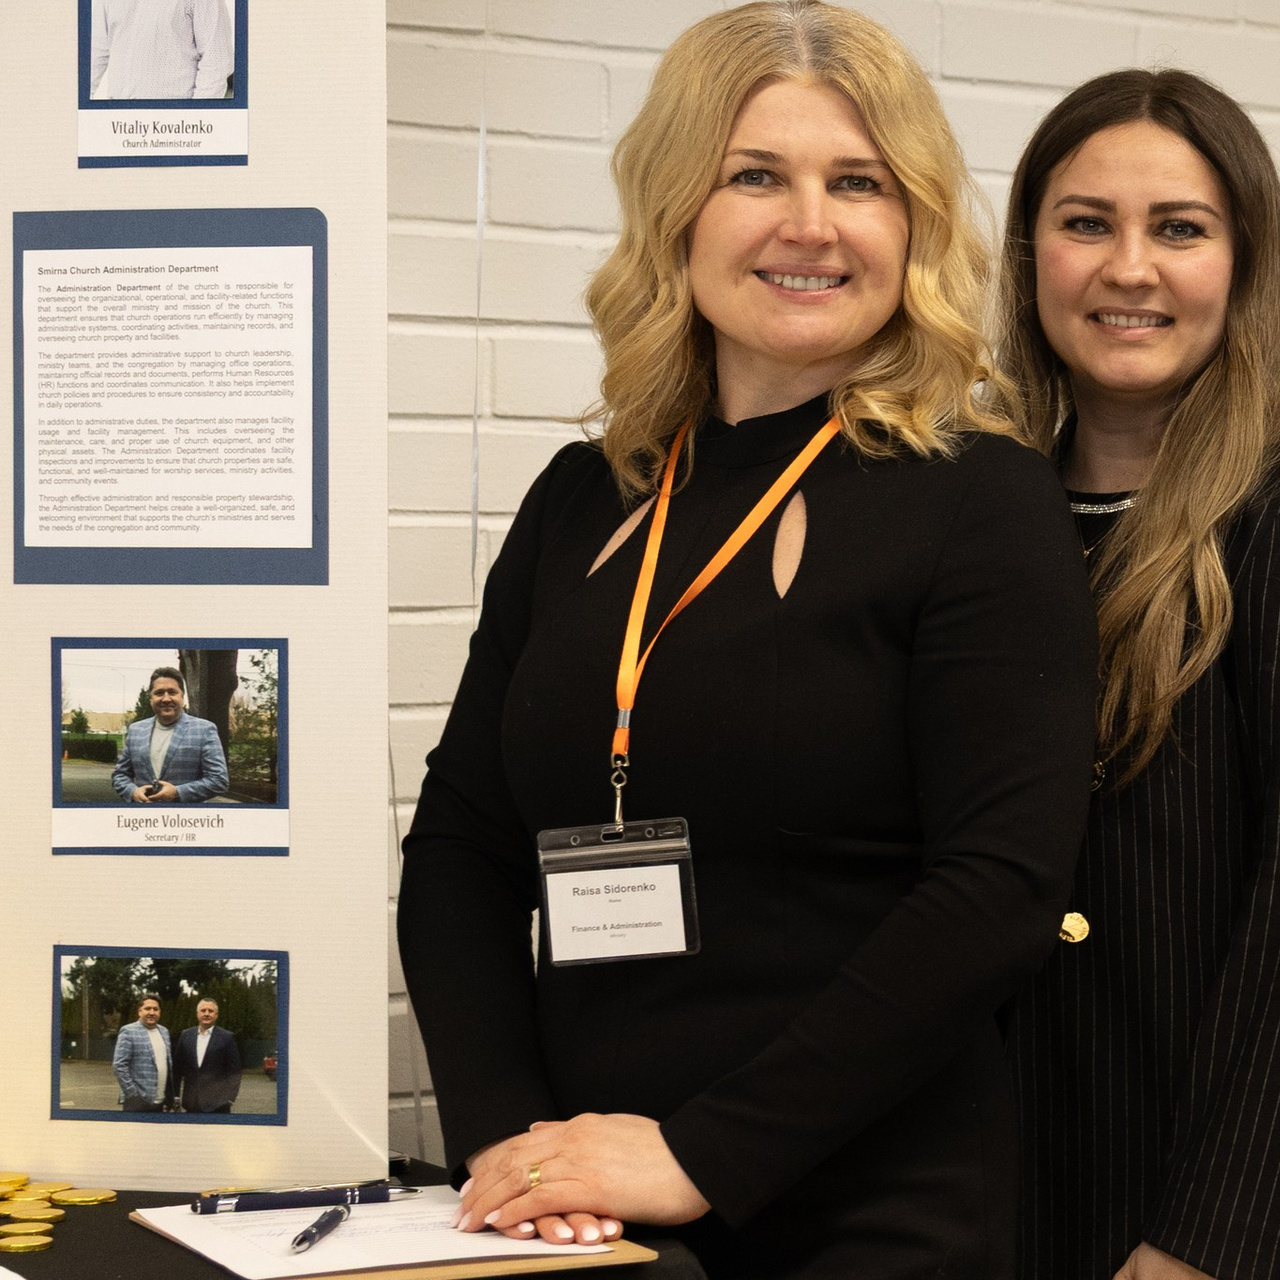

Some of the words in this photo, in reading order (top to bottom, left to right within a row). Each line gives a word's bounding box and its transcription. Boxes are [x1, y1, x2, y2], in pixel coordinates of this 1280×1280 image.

[111, 120, 149, 137] Vitaliy
[152, 120, 213, 134] Kovalenko
[122, 139, 148, 148] Church
[149, 139, 202, 148] Administrator
[38, 266, 67, 275] Smirna
[70, 266, 100, 275] Church
[103, 265, 165, 274] Administration
[168, 264, 218, 275] Department
[38, 285, 51, 293] The
[56, 285, 112, 293] Administration
[116, 284, 161, 293] Department
[178, 283, 189, 291] the
[194, 283, 219, 291] church
[236, 282, 278, 292] responsible
[284, 282, 293, 290] for
[38, 294, 76, 304] overseeing
[78, 294, 90, 302] the
[207, 292, 257, 302] facility-related
[56, 304, 82, 314] support
[87, 304, 98, 312] the
[103, 304, 127, 312] overall
[132, 304, 159, 313] ministry
[183, 303, 211, 311] mission
[228, 303, 240, 311] the
[38, 314, 78, 323] department
[127, 313, 151, 321] church
[153, 313, 191, 322] operations
[208, 312, 242, 322] efficiently
[257, 312, 293, 321] managing
[38, 323, 86, 331] administrative
[121, 323, 165, 332] coordinating
[203, 322, 245, 332] maintaining
[38, 334, 76, 343] overseeing
[78, 333, 102, 341] church
[103, 333, 133, 342] property
[135, 333, 149, 341] and
[54, 351, 95, 361] department
[97, 351, 128, 360] provides
[184, 350, 211, 360] support
[225, 350, 250, 358] church
[38, 361, 65, 371] ministry
[96, 361, 109, 369] and
[112, 361, 124, 369] the
[128, 361, 174, 370] congregation
[190, 360, 226, 370] managing
[229, 360, 249, 368] office
[38, 371, 78, 380] maintaining
[104, 370, 131, 378] records
[133, 370, 147, 378] and
[192, 370, 224, 379] performs
[254, 369, 294, 377] Resources
[38, 381, 55, 390] (HR)
[106, 380, 148, 388] coordinates
[233, 380, 253, 389] helps
[256, 379, 294, 389] implement
[63, 390, 90, 400] policies
[92, 390, 105, 398] and
[106, 390, 147, 399] procedures
[184, 390, 226, 399] consistency
[244, 389, 294, 399] accountability
[46, 401, 63, 410] daily
[38, 448, 67, 457] physical
[102, 447, 116, 455] The
[121, 447, 172, 455] Administration
[177, 447, 219, 456] Department
[271, 447, 294, 456] facility
[39, 495, 69, 504] Through
[171, 495, 213, 504] responsible
[216, 495, 246, 504] property
[117, 814, 159, 831] Eugene
[161, 814, 224, 828] Volosevich
[144, 833, 179, 844] Secretary
[185, 833, 196, 841] HR
[572, 886, 601, 897] Raisa
[603, 882, 656, 894] Sidorenko
[609, 921, 663, 930] Administration
